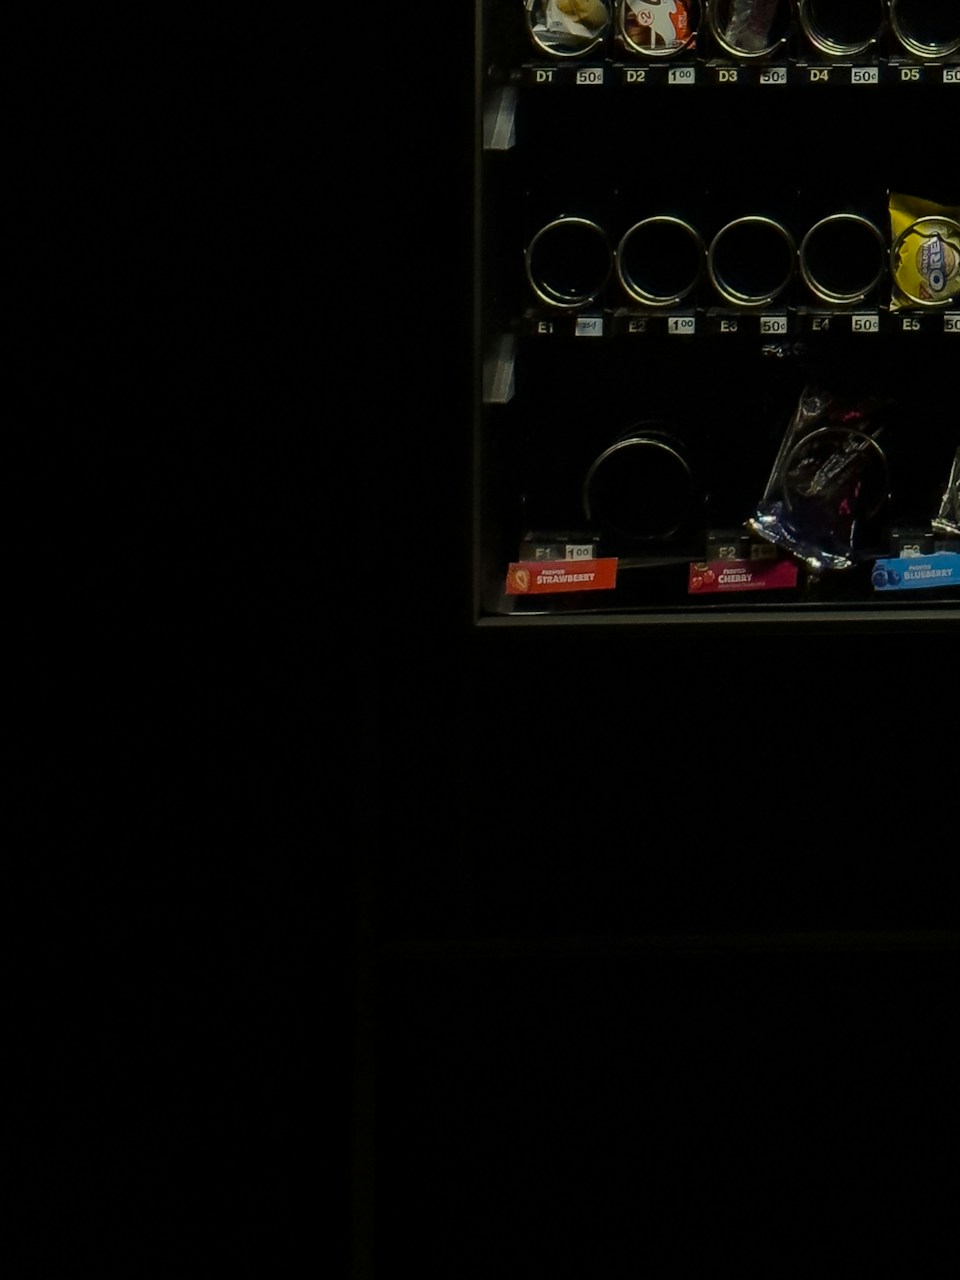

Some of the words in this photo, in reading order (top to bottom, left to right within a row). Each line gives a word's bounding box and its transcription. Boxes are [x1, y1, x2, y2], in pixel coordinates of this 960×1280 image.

[536, 71, 553, 82] D1
[626, 70, 646, 82] D2
[718, 70, 738, 82] D3
[809, 69, 829, 81] D4
[901, 69, 920, 81] D5
[720, 320, 738, 333] E3
[902, 318, 921, 331] E5
[535, 547, 553, 560] F1
[719, 546, 737, 559] F2
[536, 573, 596, 585] STRAWBERRY
[717, 573, 753, 584] CHERRY
[903, 568, 954, 580] BLUEBERRY
